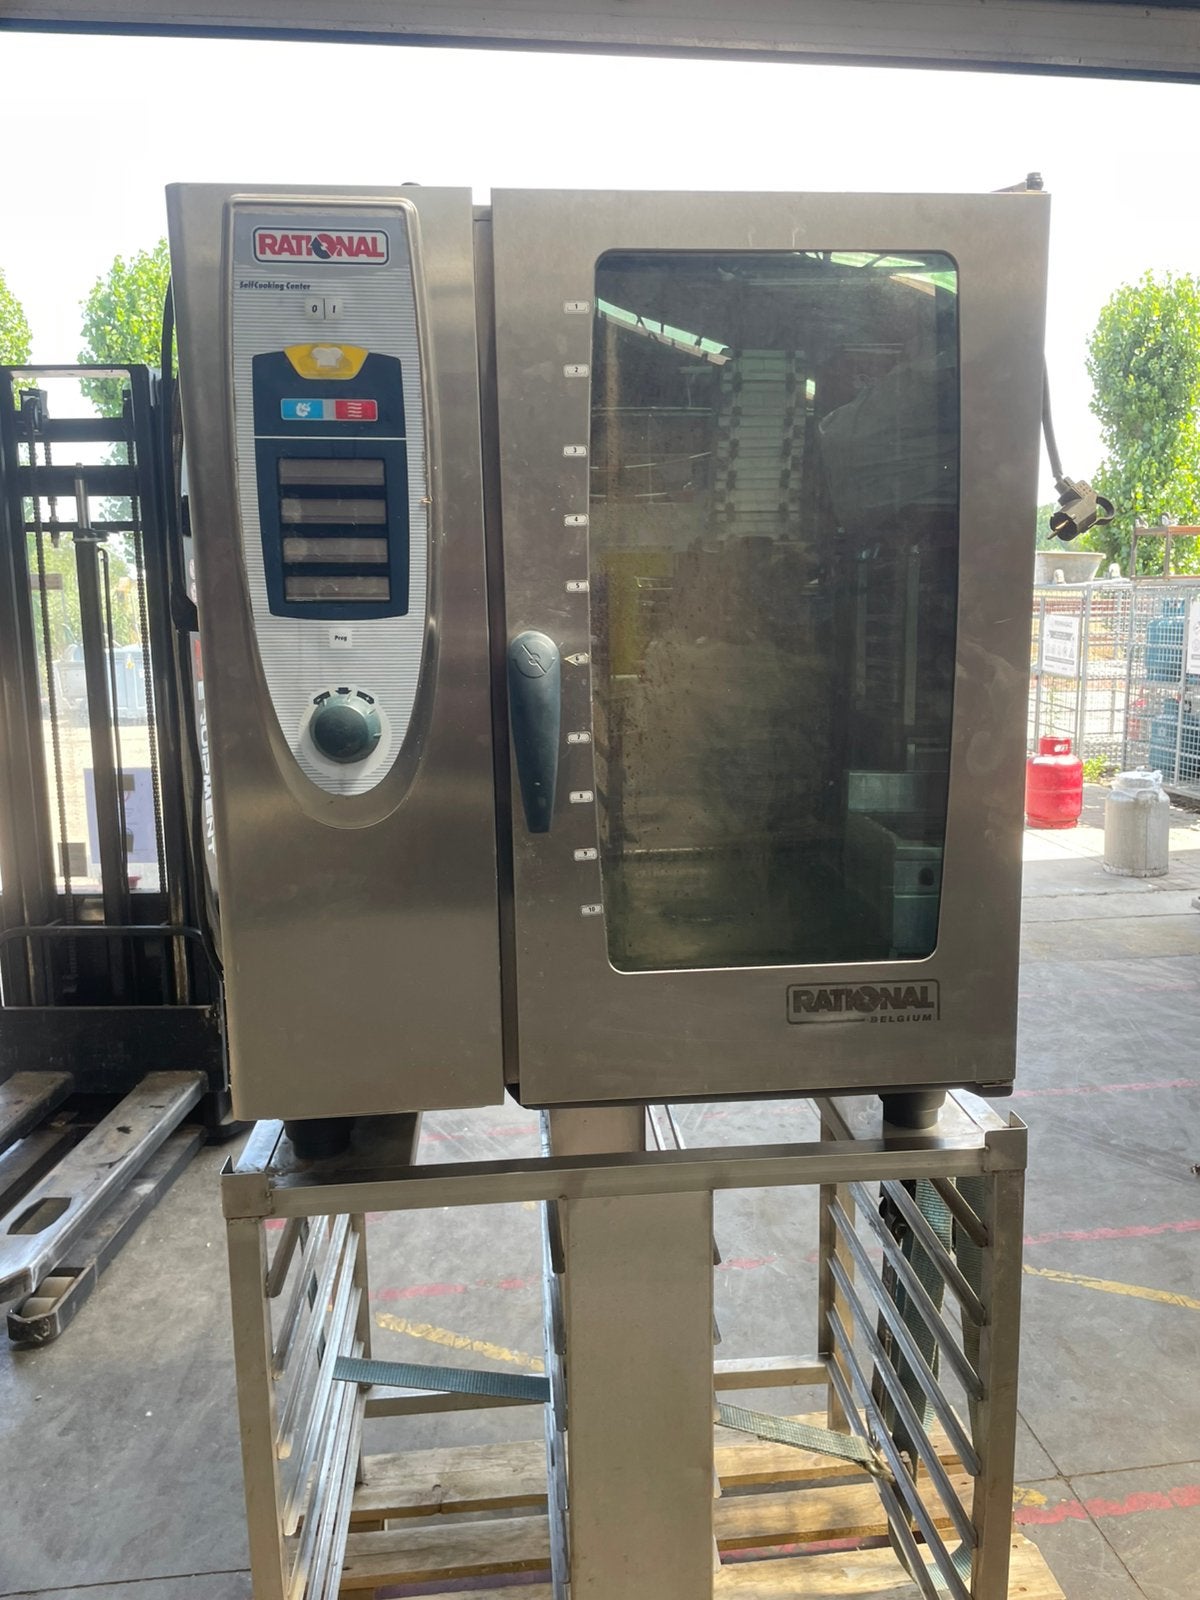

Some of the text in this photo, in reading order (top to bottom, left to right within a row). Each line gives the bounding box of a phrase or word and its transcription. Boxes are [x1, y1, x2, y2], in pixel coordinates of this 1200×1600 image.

[258, 233, 385, 260] RATIONAL
[240, 281, 311, 291] SelfCooking Center
[793, 986, 934, 1013] RATIONAL
[869, 1014, 932, 1023] BELGIUM
